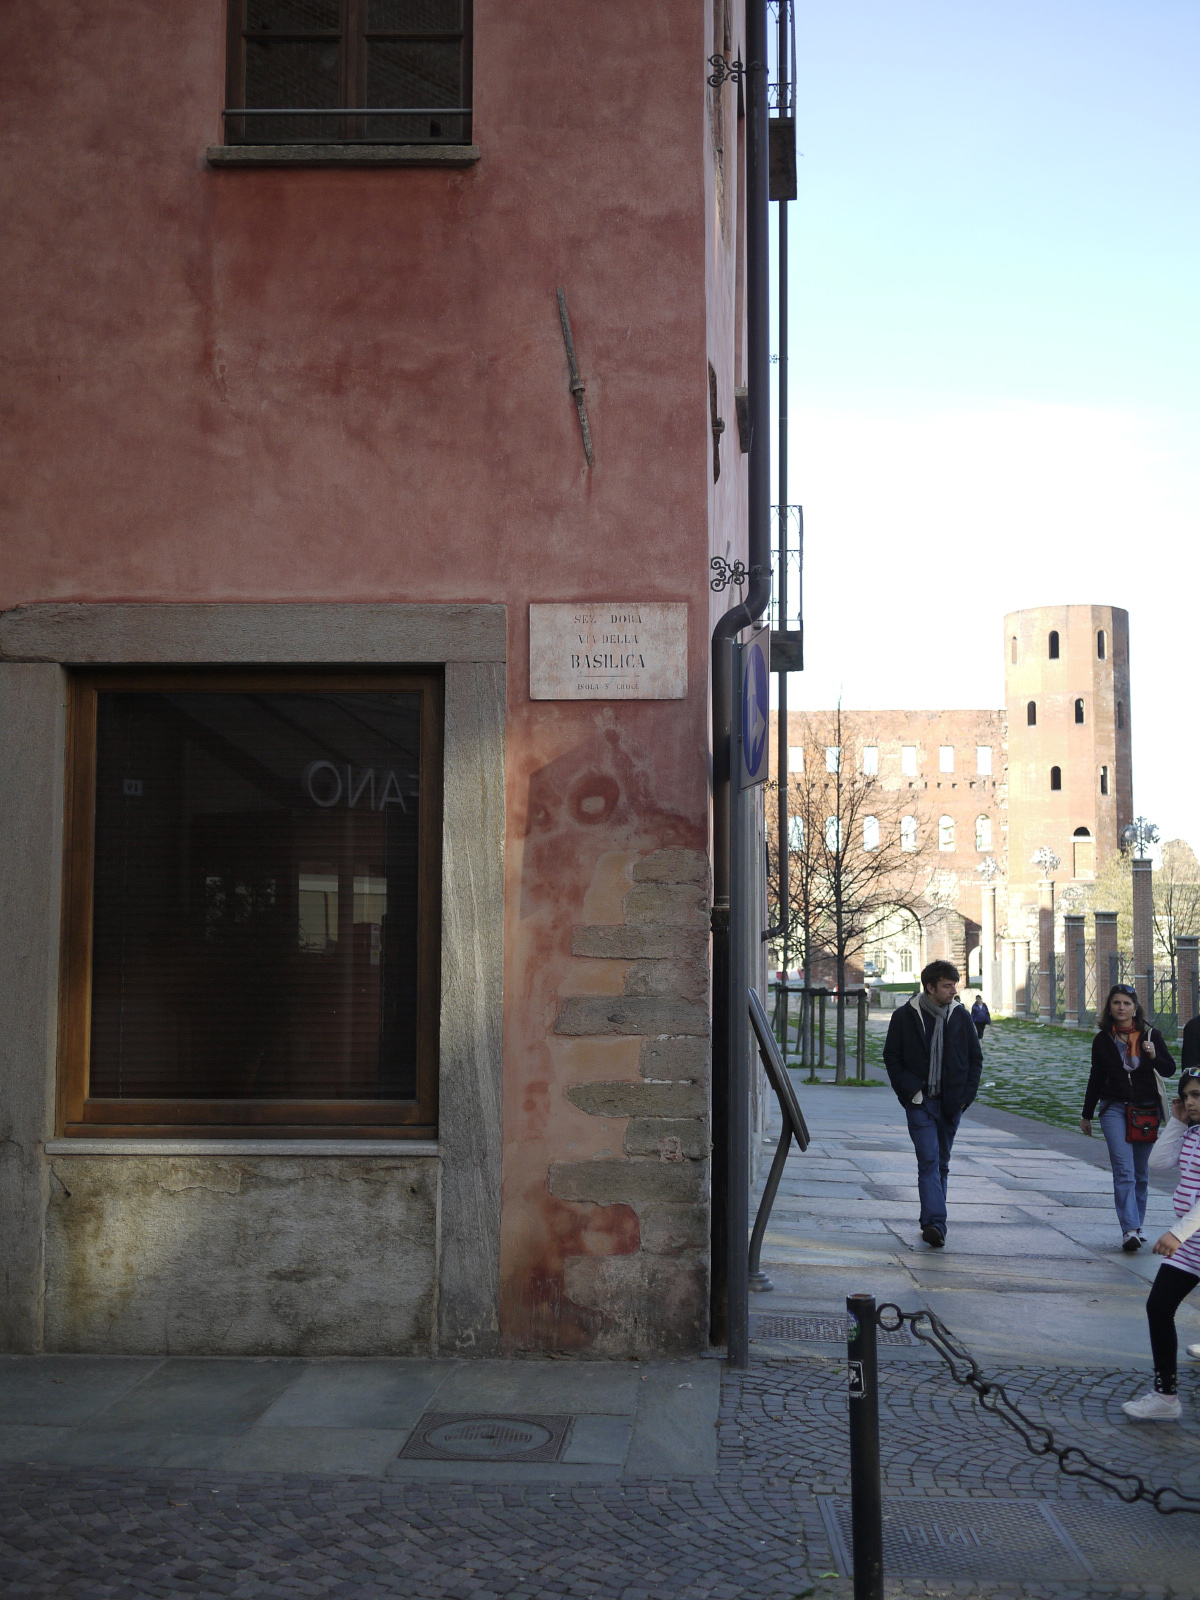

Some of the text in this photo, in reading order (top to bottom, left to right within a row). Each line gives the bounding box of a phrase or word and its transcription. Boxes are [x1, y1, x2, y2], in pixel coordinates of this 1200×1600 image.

[611, 614, 643, 624] DORA
[578, 634, 639, 644] VIA DELLA
[571, 654, 646, 669] BASILICA
